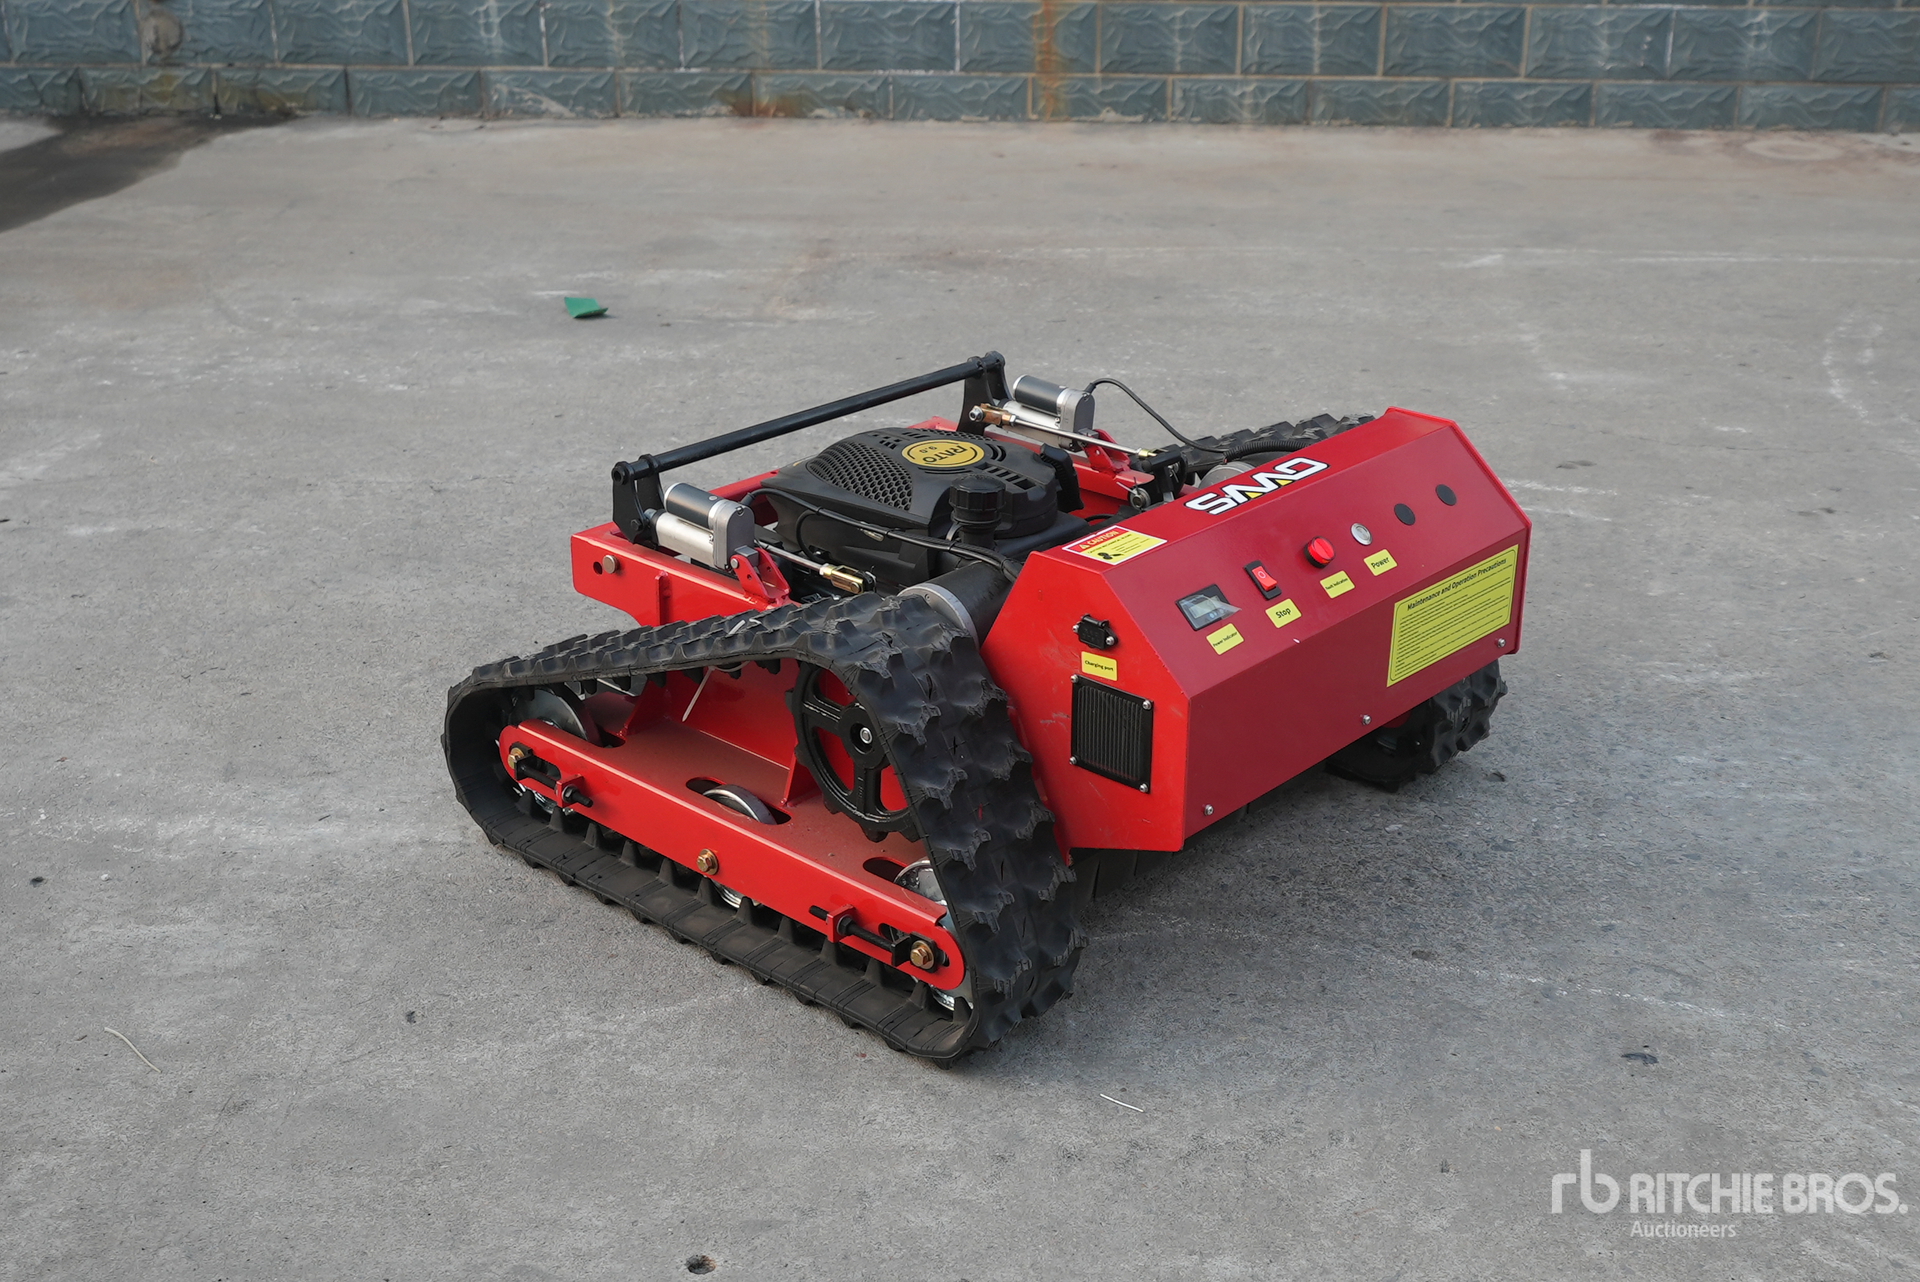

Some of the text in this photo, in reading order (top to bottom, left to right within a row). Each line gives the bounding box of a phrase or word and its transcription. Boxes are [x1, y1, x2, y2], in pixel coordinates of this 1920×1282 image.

[923, 445, 968, 463] RATO
[1087, 530, 1120, 546] CAUTION
[1370, 555, 1391, 569] Power
[1407, 558, 1507, 611] Maintenance and Operation Precautions
[1275, 605, 1292, 620] Stop
[1085, 660, 1104, 670] Charging
